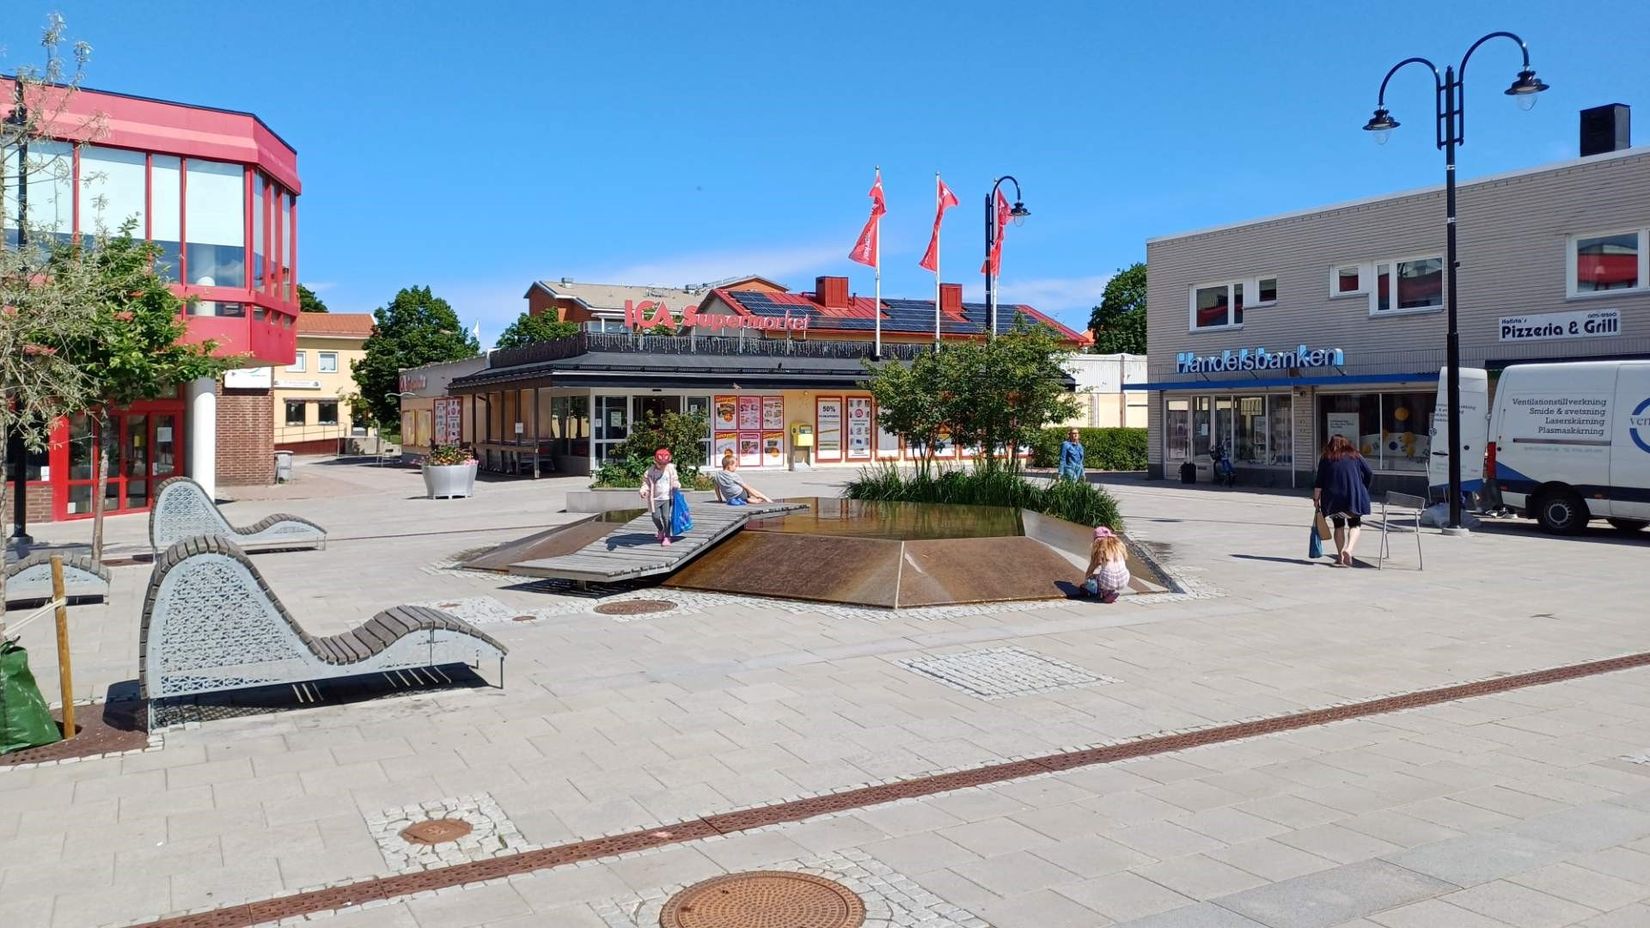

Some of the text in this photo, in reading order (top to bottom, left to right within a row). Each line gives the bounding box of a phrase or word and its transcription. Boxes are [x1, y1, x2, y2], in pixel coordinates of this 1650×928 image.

[624, 300, 811, 332] ICA Supermarket
[1501, 318, 1618, 338] Pizzeria & Grill
[1176, 345, 1344, 374] Handelsbanken
[822, 405, 836, 413] 50%
[1512, 398, 1607, 407] Ventilationstillverkning
[1565, 408, 1606, 417] svetsning
